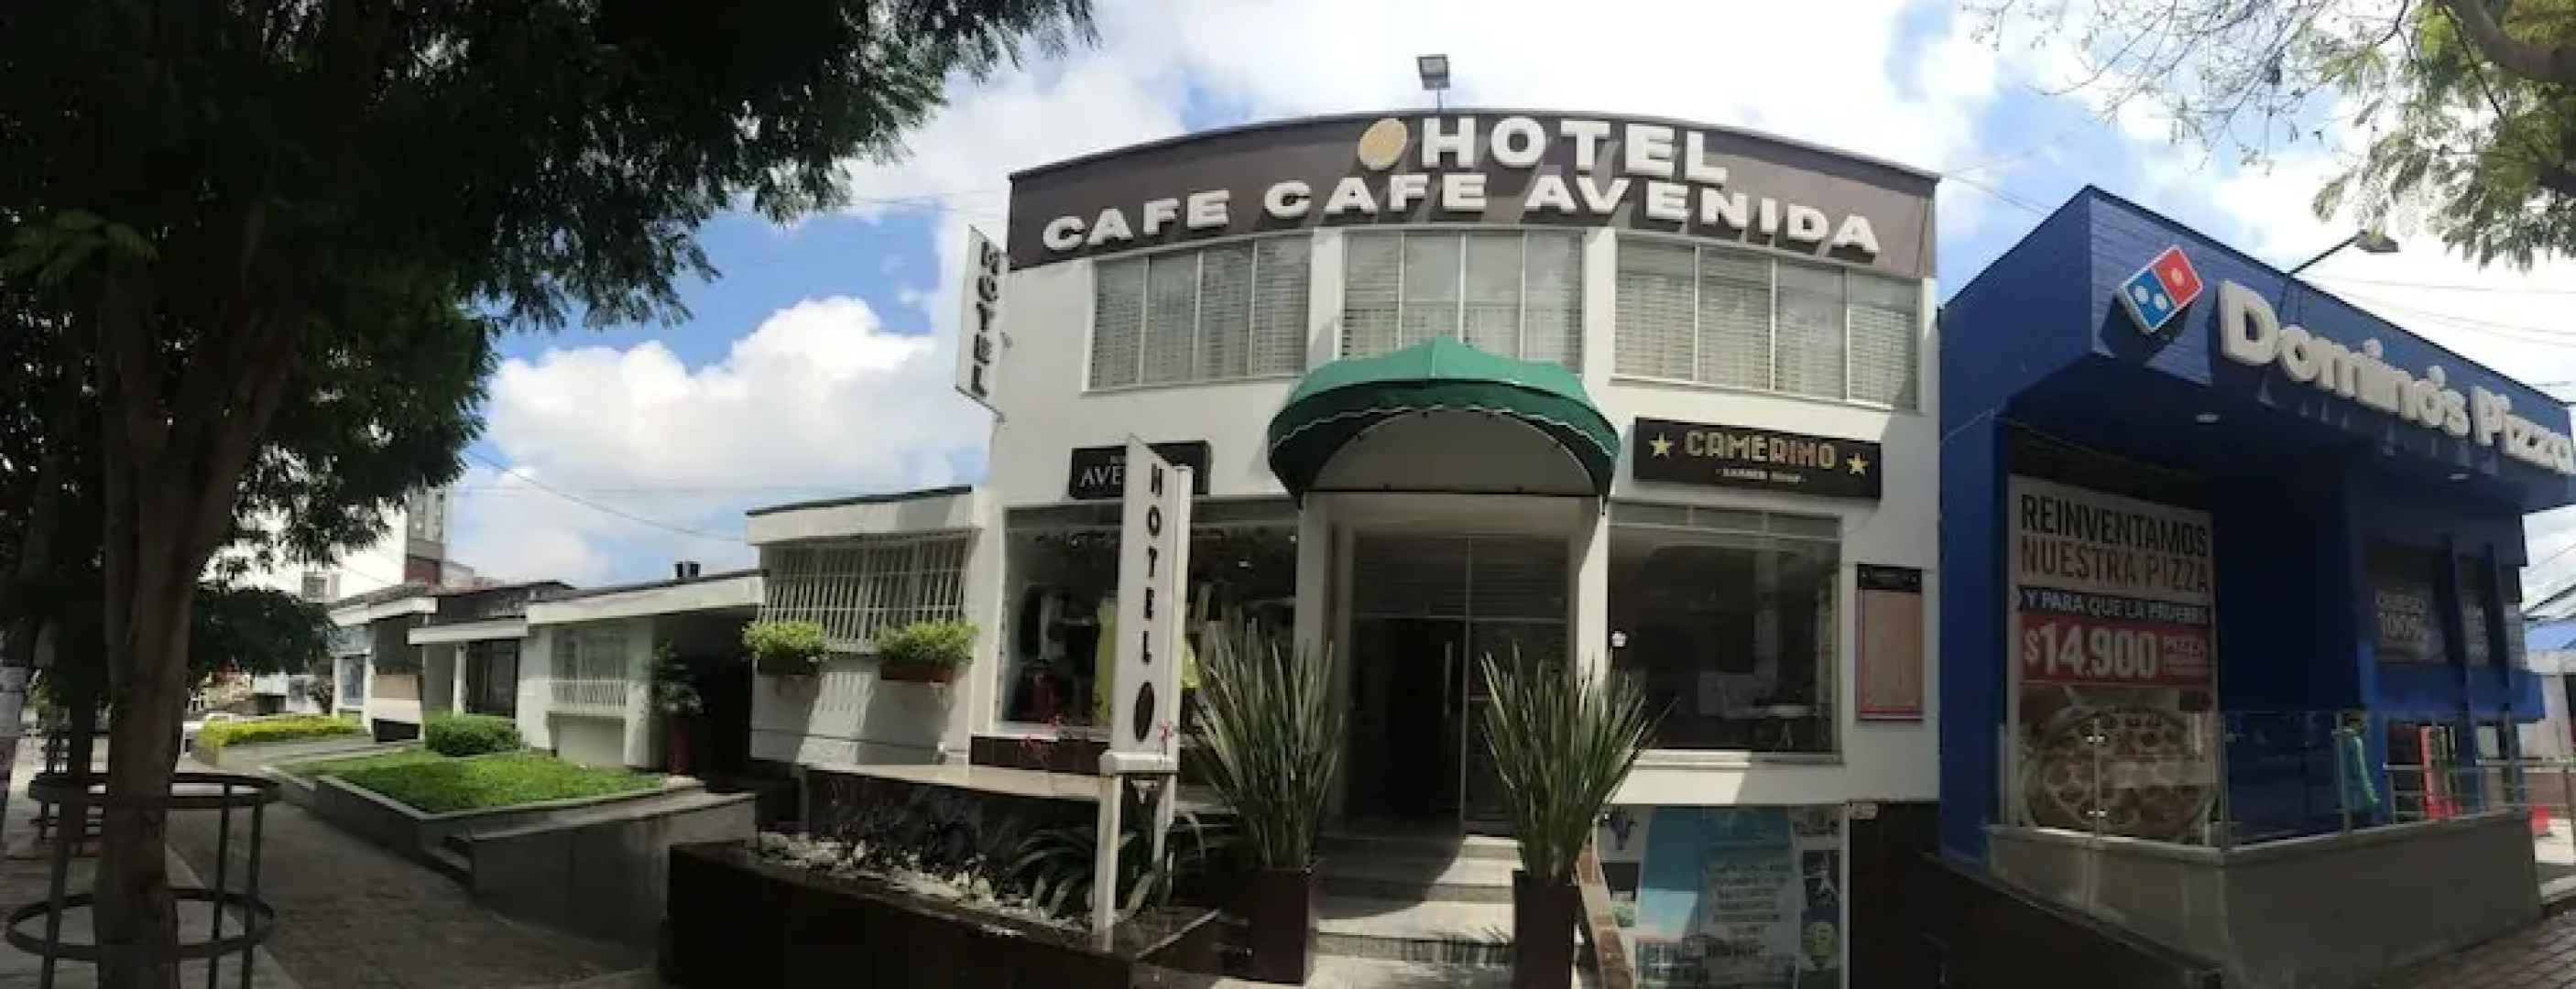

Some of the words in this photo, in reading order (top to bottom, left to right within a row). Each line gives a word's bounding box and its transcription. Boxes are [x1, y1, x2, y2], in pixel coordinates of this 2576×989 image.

[1422, 115, 1729, 184] HOTEL
[1042, 190, 1231, 251] CAFE
[1263, 173, 1487, 220] CAFE
[1523, 174, 1882, 254] AVENIDA
[971, 241, 1000, 398] HOTEL
[1684, 429, 1836, 471] CAMERINO
[2021, 493, 2207, 558] REINVENTAMOS
[1141, 462, 1165, 666] HOTEL
[2021, 535, 2137, 588] NUESTRA
[2145, 552, 2210, 593] PIZZA
[2025, 589, 2040, 609] Y
[2041, 592, 2085, 613] PARA
[2089, 595, 2123, 617] QUE
[2124, 599, 2147, 619] LA
